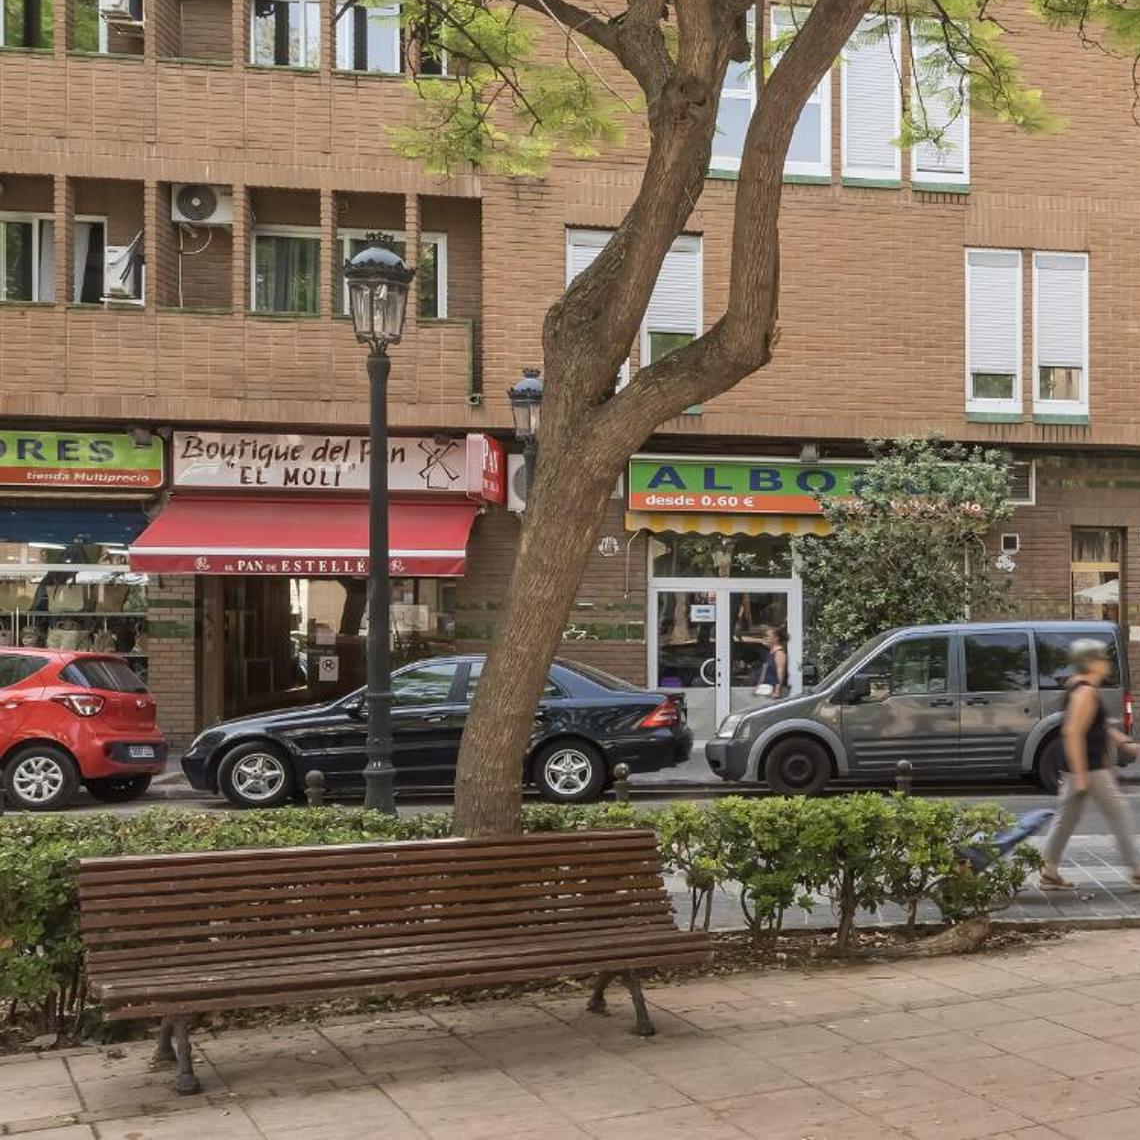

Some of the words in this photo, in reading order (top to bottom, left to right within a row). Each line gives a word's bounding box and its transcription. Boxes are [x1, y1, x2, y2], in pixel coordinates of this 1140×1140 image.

[0, 438, 114, 463] RES
[181, 435, 303, 468] Boutique
[311, 438, 350, 462] del
[360, 438, 405, 463] Pn
[26, 471, 70, 481] tienda
[73, 472, 149, 483] Multiprecio
[645, 495, 695, 506] desde
[701, 496, 738, 507] 0.60
[743, 496, 754, 507] €
[238, 560, 263, 572] PAN
